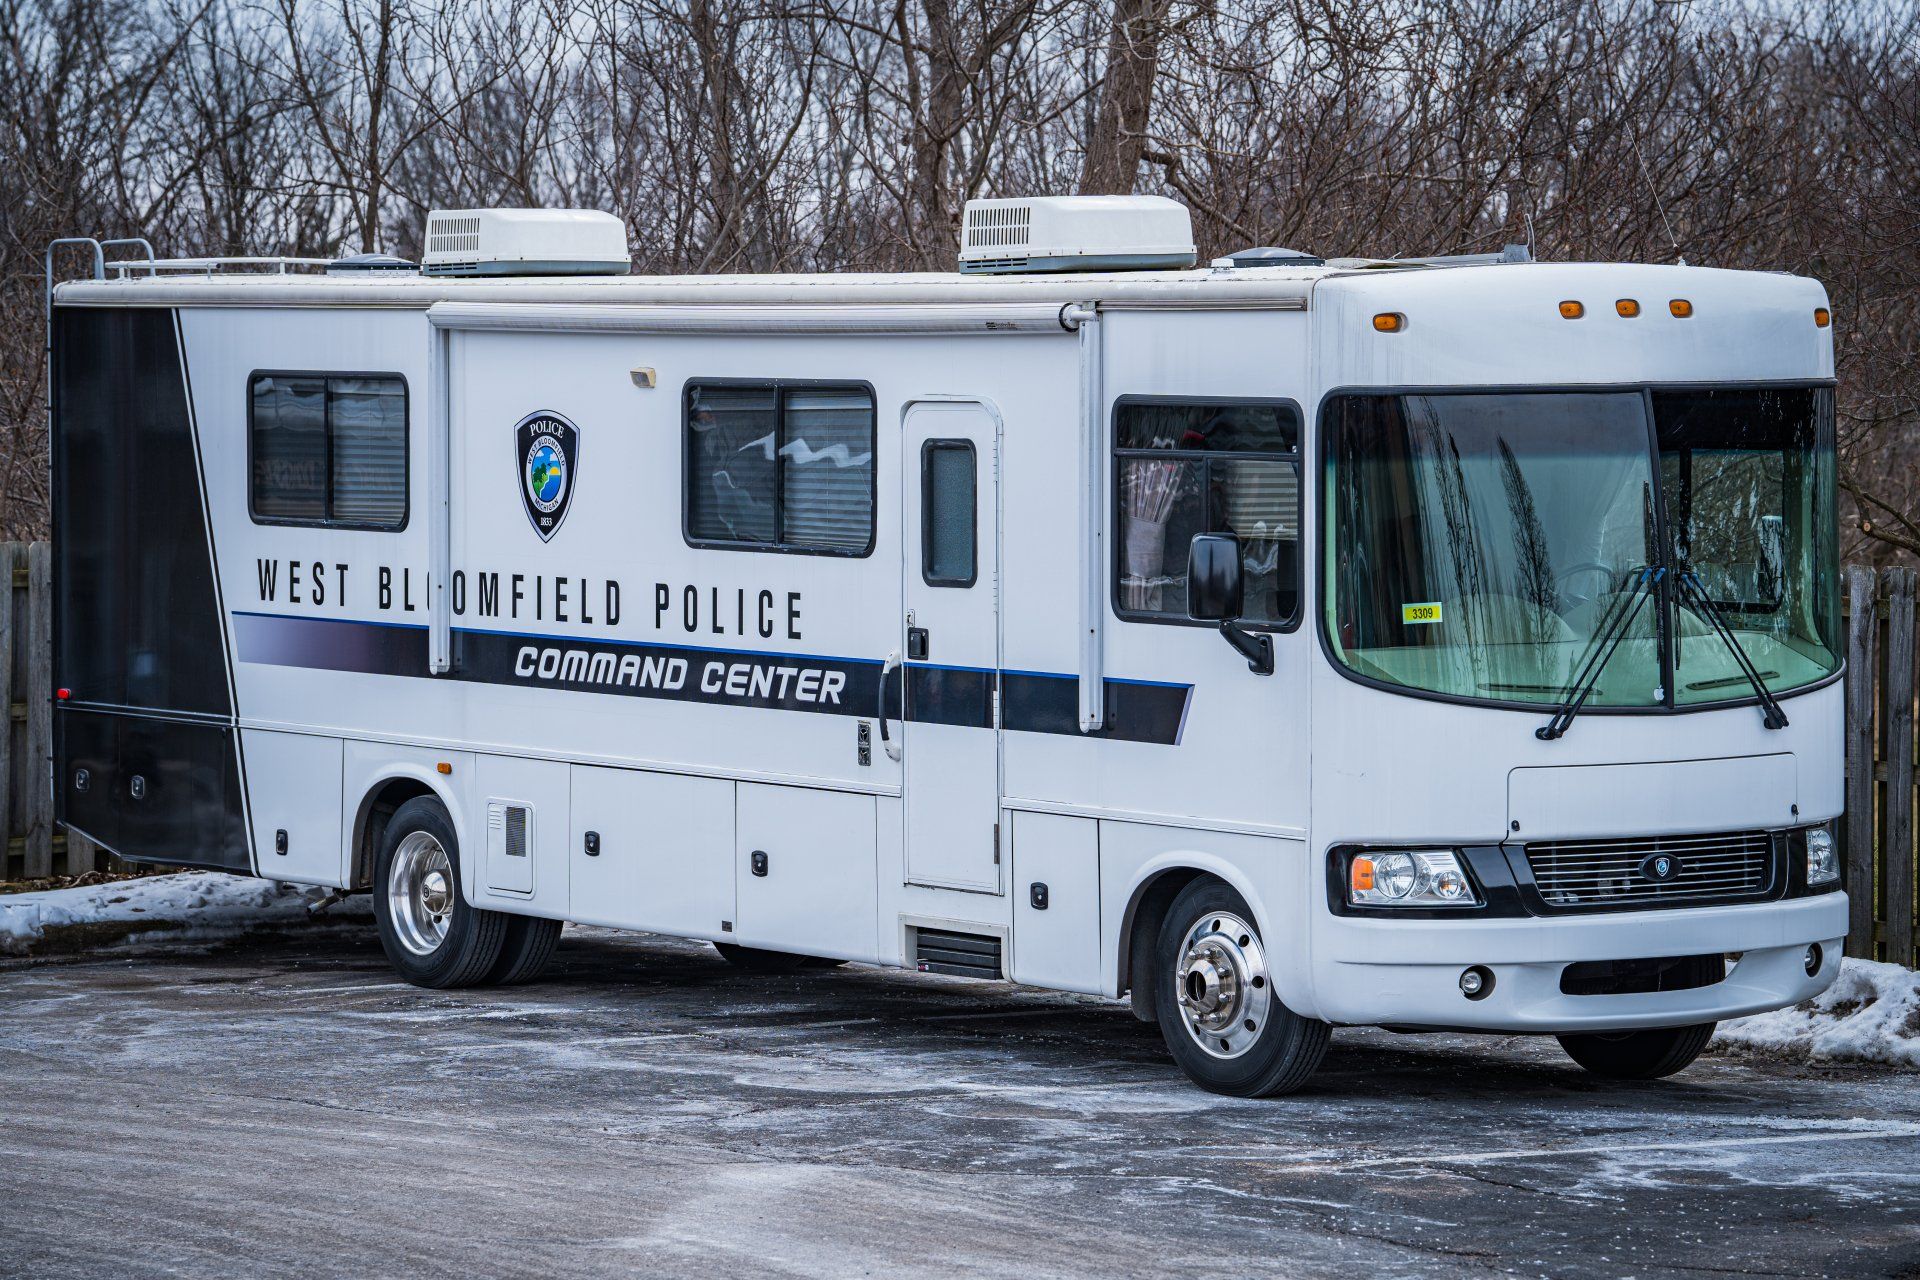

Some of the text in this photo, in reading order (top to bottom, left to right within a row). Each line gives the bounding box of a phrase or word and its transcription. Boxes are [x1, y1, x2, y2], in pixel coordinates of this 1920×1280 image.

[530, 420, 564, 438] POLICE
[528, 437, 566, 466] WEST BLOOMFIELD
[534, 497, 559, 511] MICHIGAN
[257, 558, 802, 640] WEST BLOMFIELD POLICE
[1412, 607, 1433, 620] 3309
[514, 646, 847, 705] COMMAND CENTER
